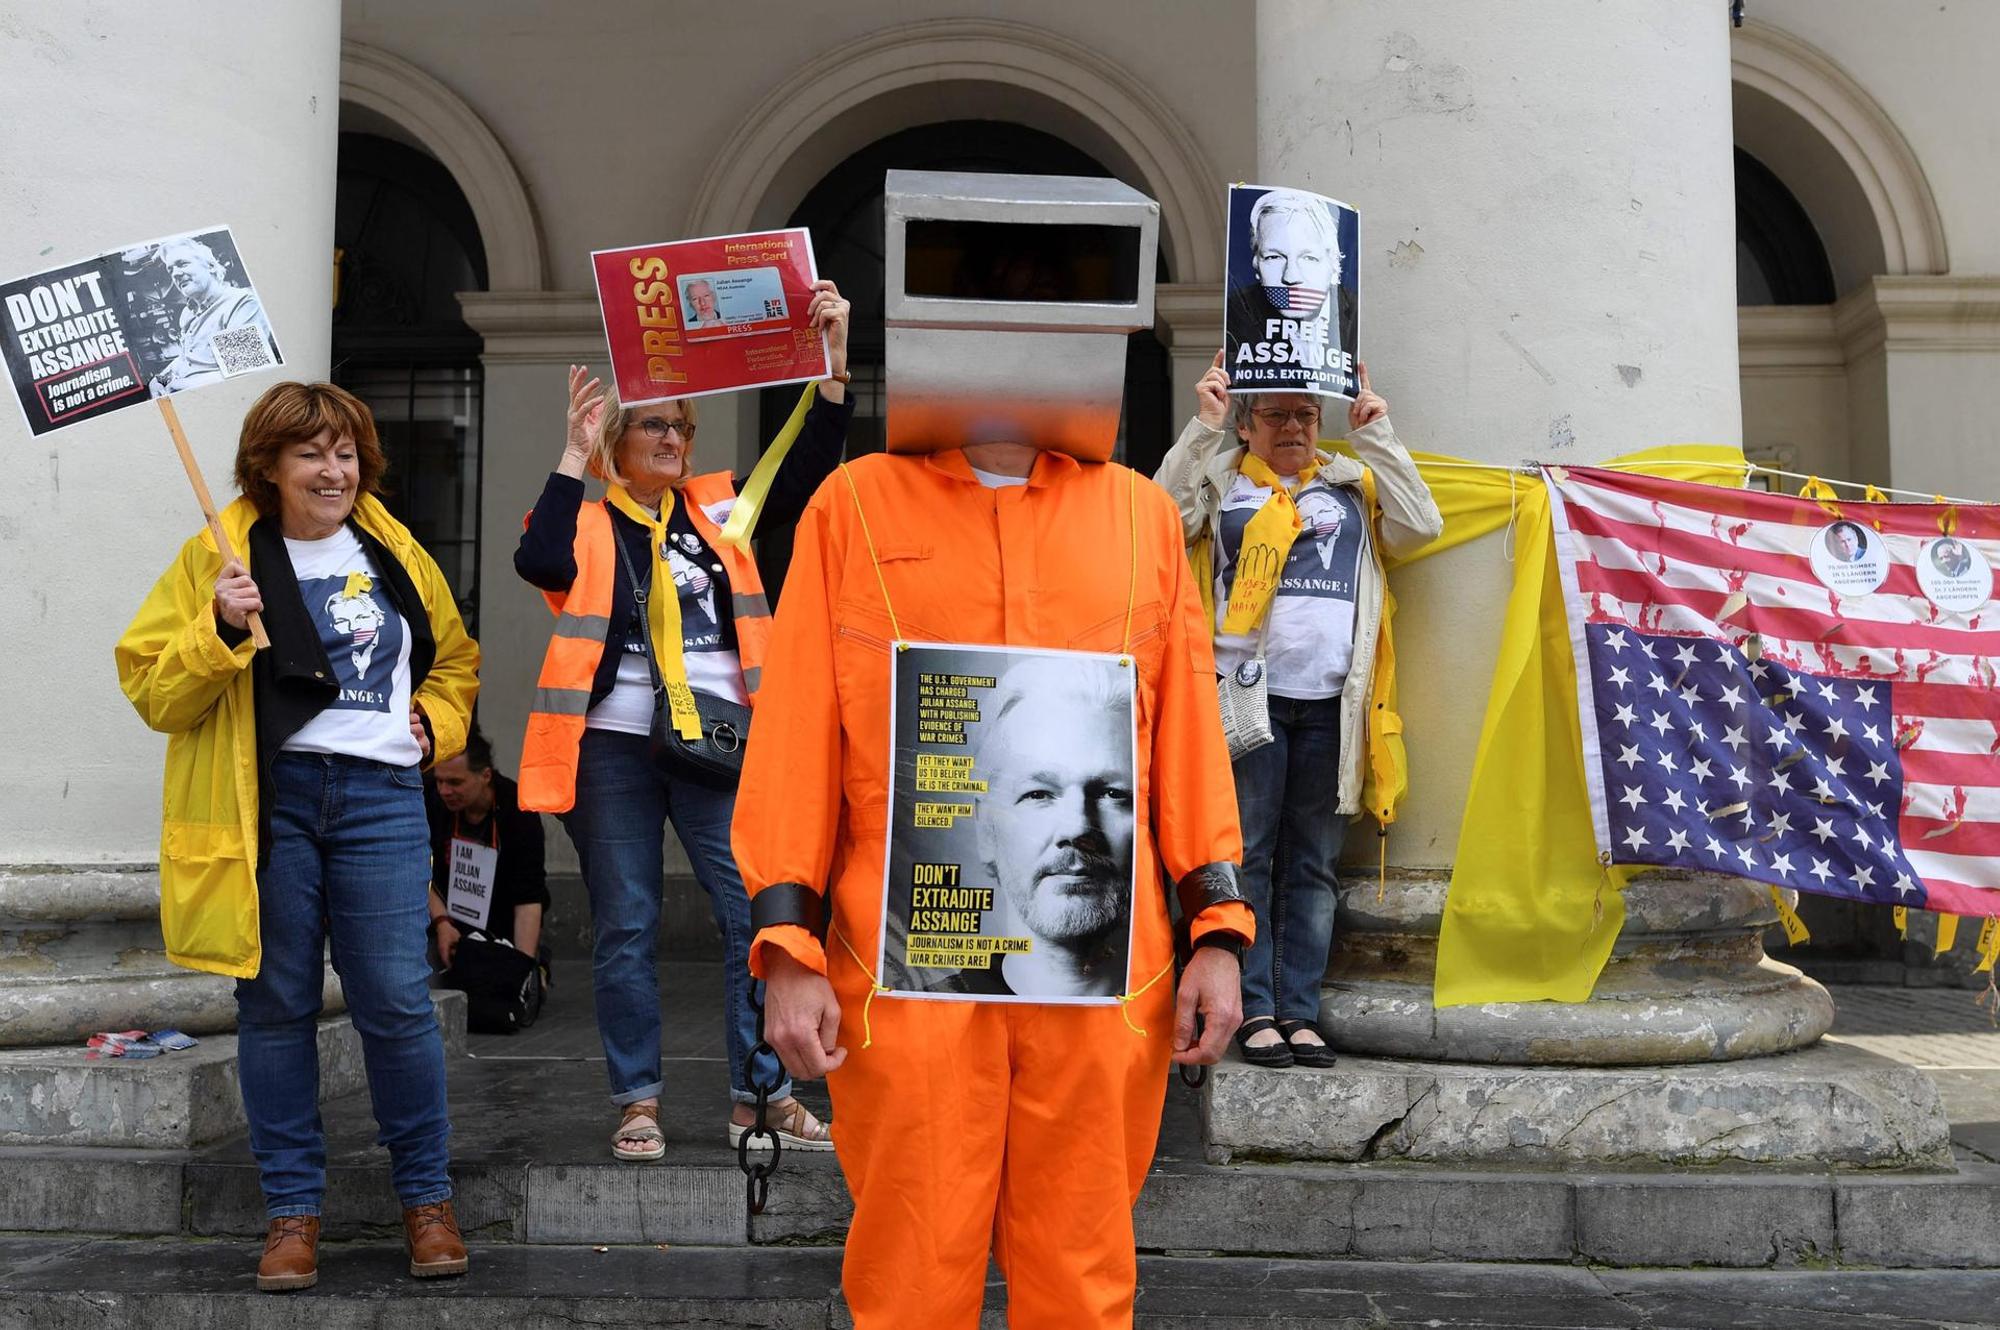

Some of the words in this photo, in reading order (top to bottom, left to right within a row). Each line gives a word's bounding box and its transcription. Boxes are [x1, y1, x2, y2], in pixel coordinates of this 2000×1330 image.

[724, 240, 793, 253] International
[728, 255, 759, 265] Press
[762, 251, 787, 262] Card
[5, 270, 106, 332] DON'T
[630, 257, 688, 383] PRESS
[18, 308, 120, 354] EXTRADITE
[727, 324, 753, 334] PRESS
[1266, 318, 1329, 344] FREE
[29, 330, 130, 380] ASSANGE
[1236, 342, 1353, 373] ASSANGE
[48, 366, 112, 399] Journalism
[1235, 370, 1252, 380] NO
[1255, 369, 1278, 380] U.S.
[1280, 370, 1354, 389] EXTRADITION
[53, 400, 65, 413] is
[66, 390, 86, 408] not
[87, 388, 95, 400] a
[96, 376, 134, 396] crime.
[920, 674, 933, 684] THE
[934, 675, 948, 684] U.S.
[950, 676, 994, 686] GOVERNMENT
[336, 689, 374, 702] ANGE
[920, 686, 934, 696] HAS
[936, 687, 966, 697] CHARGED
[920, 698, 944, 707] JULIAN
[946, 698, 976, 708] ASSANGE
[920, 710, 938, 718] WITH
[940, 710, 980, 720] PUBLISHING
[920, 721, 952, 731] EVIDENCE
[954, 722, 962, 732] OF
[920, 732, 936, 742] WAR
[938, 733, 966, 744] CRIMES.
[920, 756, 931, 766] YET
[934, 757, 950, 766] THEY
[952, 758, 972, 768] WANT
[918, 768, 928, 778] US
[930, 769, 938, 778] TO
[940, 770, 966, 778] BELIEVE
[918, 780, 926, 789] HE
[928, 781, 936, 790] IS
[938, 782, 950, 790] THE
[952, 782, 986, 792] CRIMINAL.
[918, 804, 936, 814] THEY
[936, 805, 956, 814] WANT
[958, 806, 970, 814] HIM
[917, 817, 950, 826] SILENCED.
[460, 845, 473, 860] AM
[454, 862, 480, 880] JULIAN
[914, 864, 958, 886] DON'T
[453, 877, 487, 898] ASSANGE
[912, 888, 992, 910] EXTRADITE
[910, 910, 980, 932] ASSANGE
[910, 936, 964, 950] JOURNALISM
[966, 938, 974, 950] IS
[976, 939, 992, 950] NOT
[994, 940, 1000, 950] A
[1002, 940, 1028, 952] CRIME
[910, 952, 930, 964] WAR
[932, 954, 964, 966] CRIMES
[967, 954, 988, 966] ARE!
